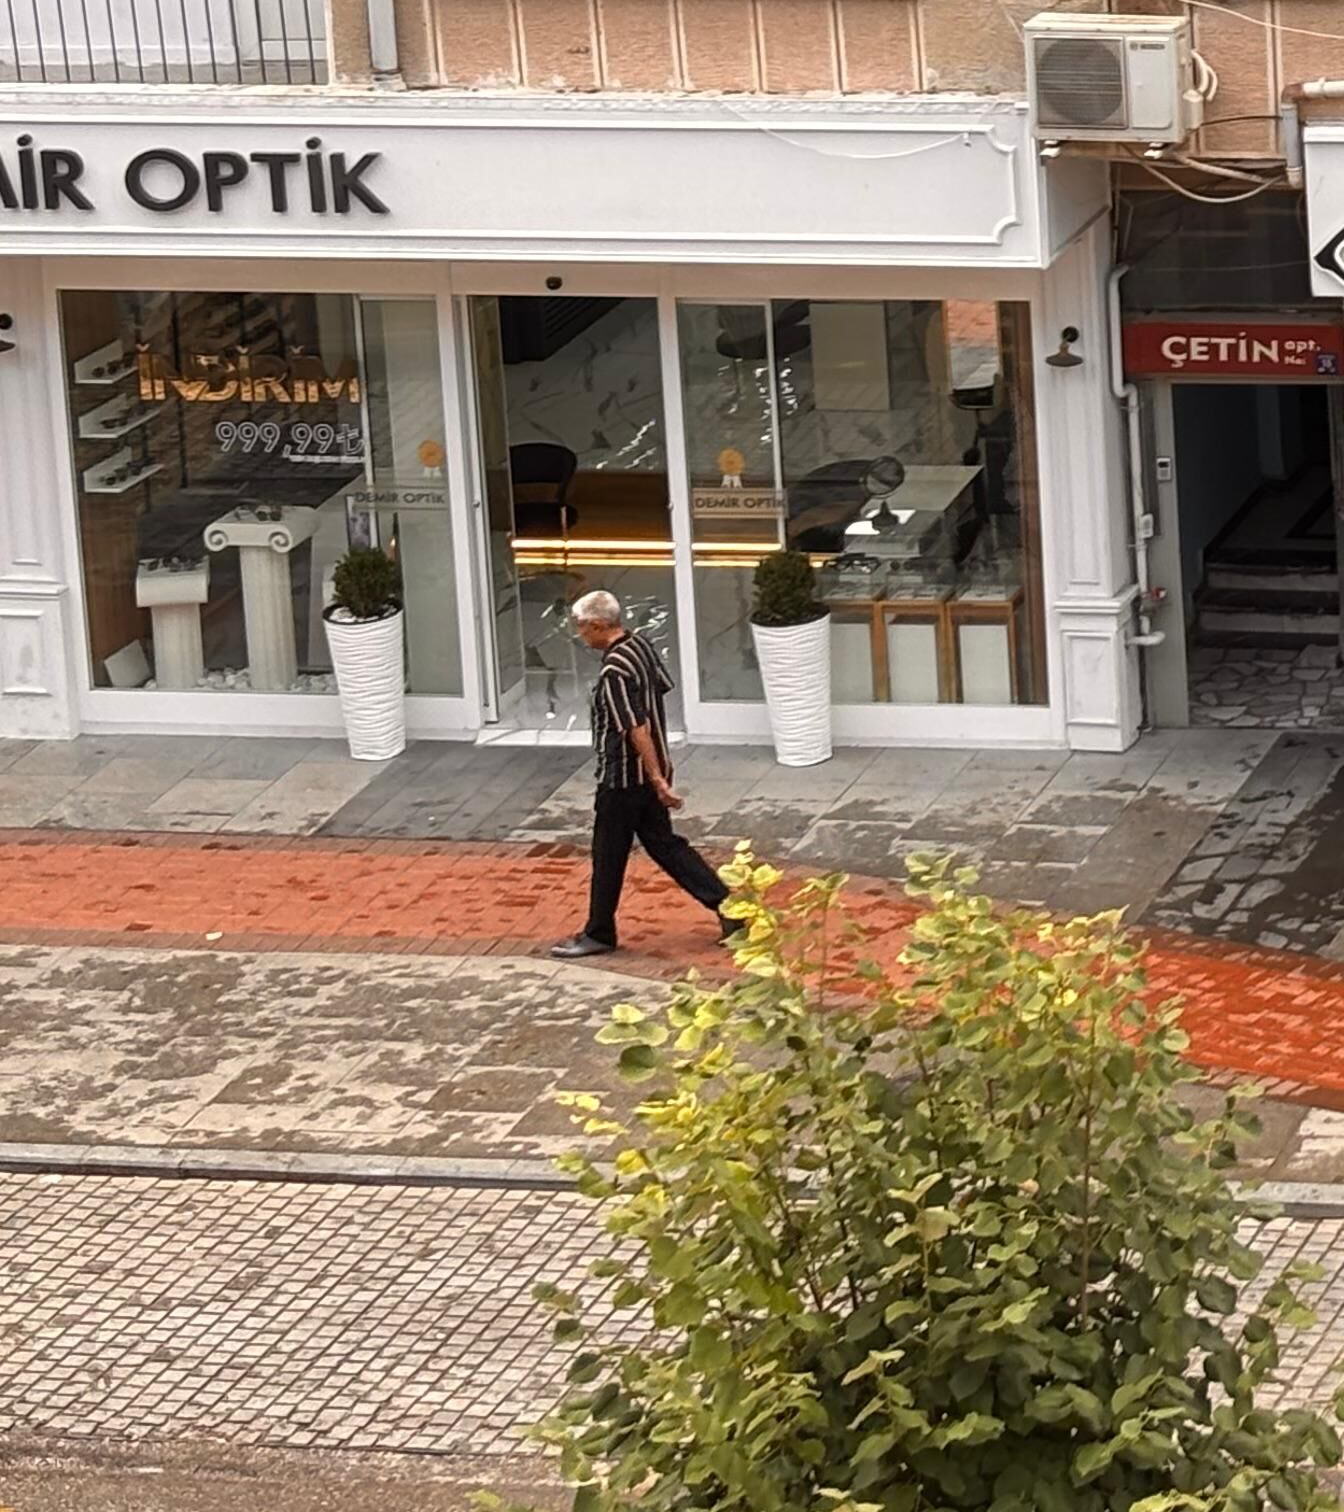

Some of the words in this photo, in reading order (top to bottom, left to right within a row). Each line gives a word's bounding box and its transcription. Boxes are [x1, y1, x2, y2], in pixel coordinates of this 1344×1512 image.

[0, 133, 96, 210] İR
[125, 136, 391, 215] OPTİK
[137, 343, 361, 403] İNDİRİM
[1161, 331, 1280, 368] ÇETİN
[403, 492, 445, 504] OPTİK
